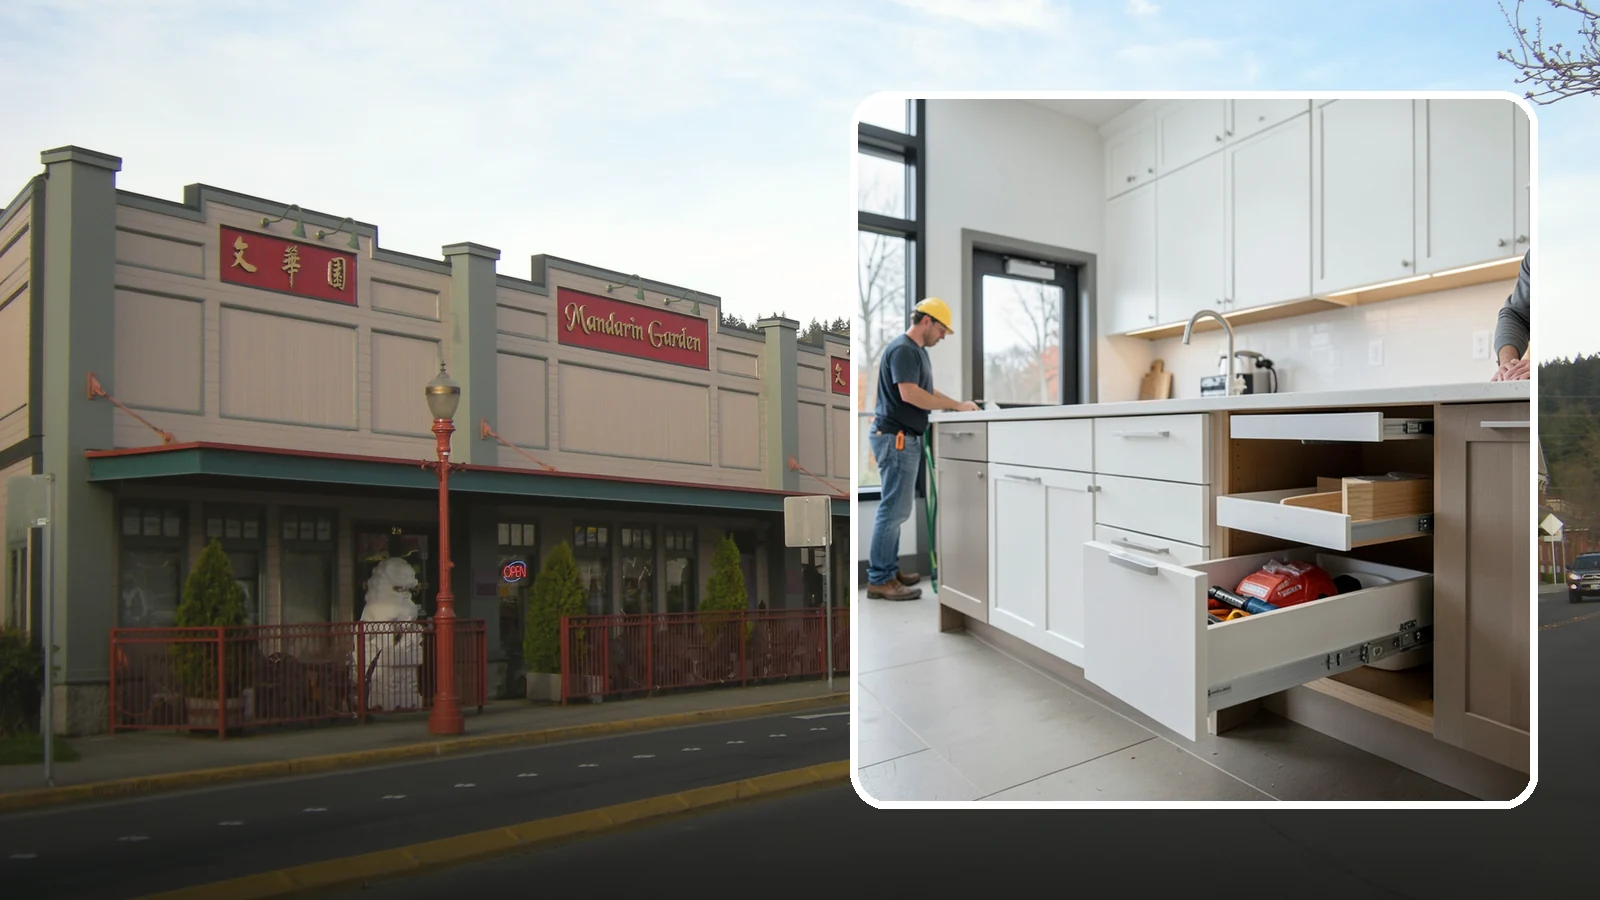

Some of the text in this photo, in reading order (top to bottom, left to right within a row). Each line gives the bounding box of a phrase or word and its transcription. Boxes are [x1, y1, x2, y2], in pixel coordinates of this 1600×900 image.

[231, 236, 346, 290] 文華園
[565, 302, 702, 352] Mandarin Garden
[503, 565, 527, 578] OPEN
